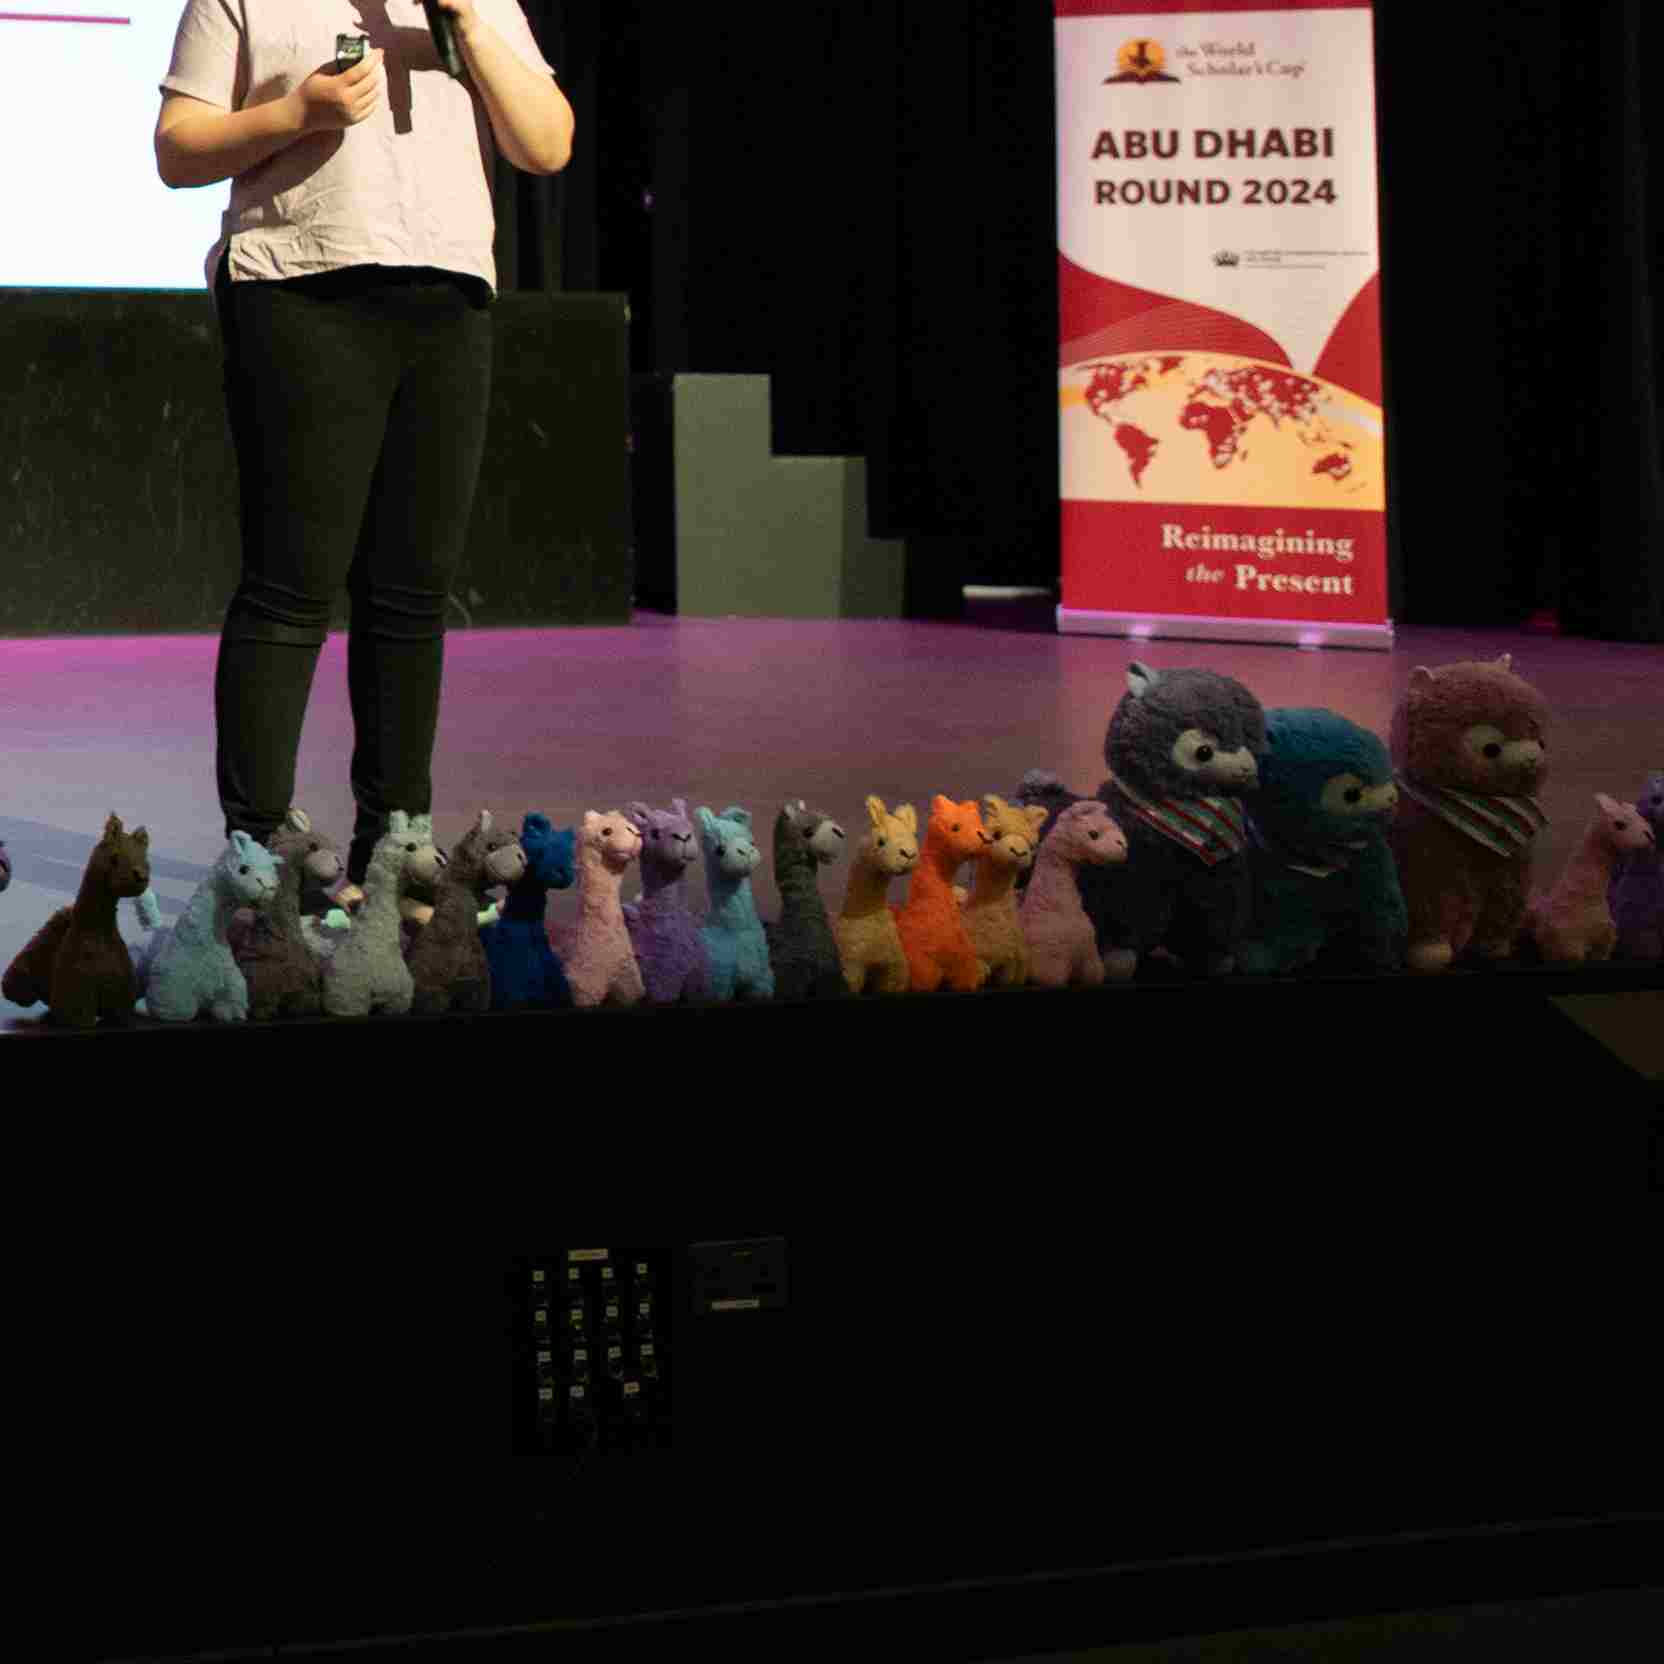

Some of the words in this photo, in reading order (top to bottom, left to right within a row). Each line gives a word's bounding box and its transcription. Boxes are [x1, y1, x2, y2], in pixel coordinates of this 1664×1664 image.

[1091, 130, 1180, 161] ABU
[1194, 128, 1335, 160] DHABI
[1095, 179, 1232, 206] ROUND
[1242, 179, 1338, 206] 2024
[1161, 523, 1356, 563] Reimagining
[1184, 563, 1226, 584] the
[1235, 564, 1354, 596] Present
